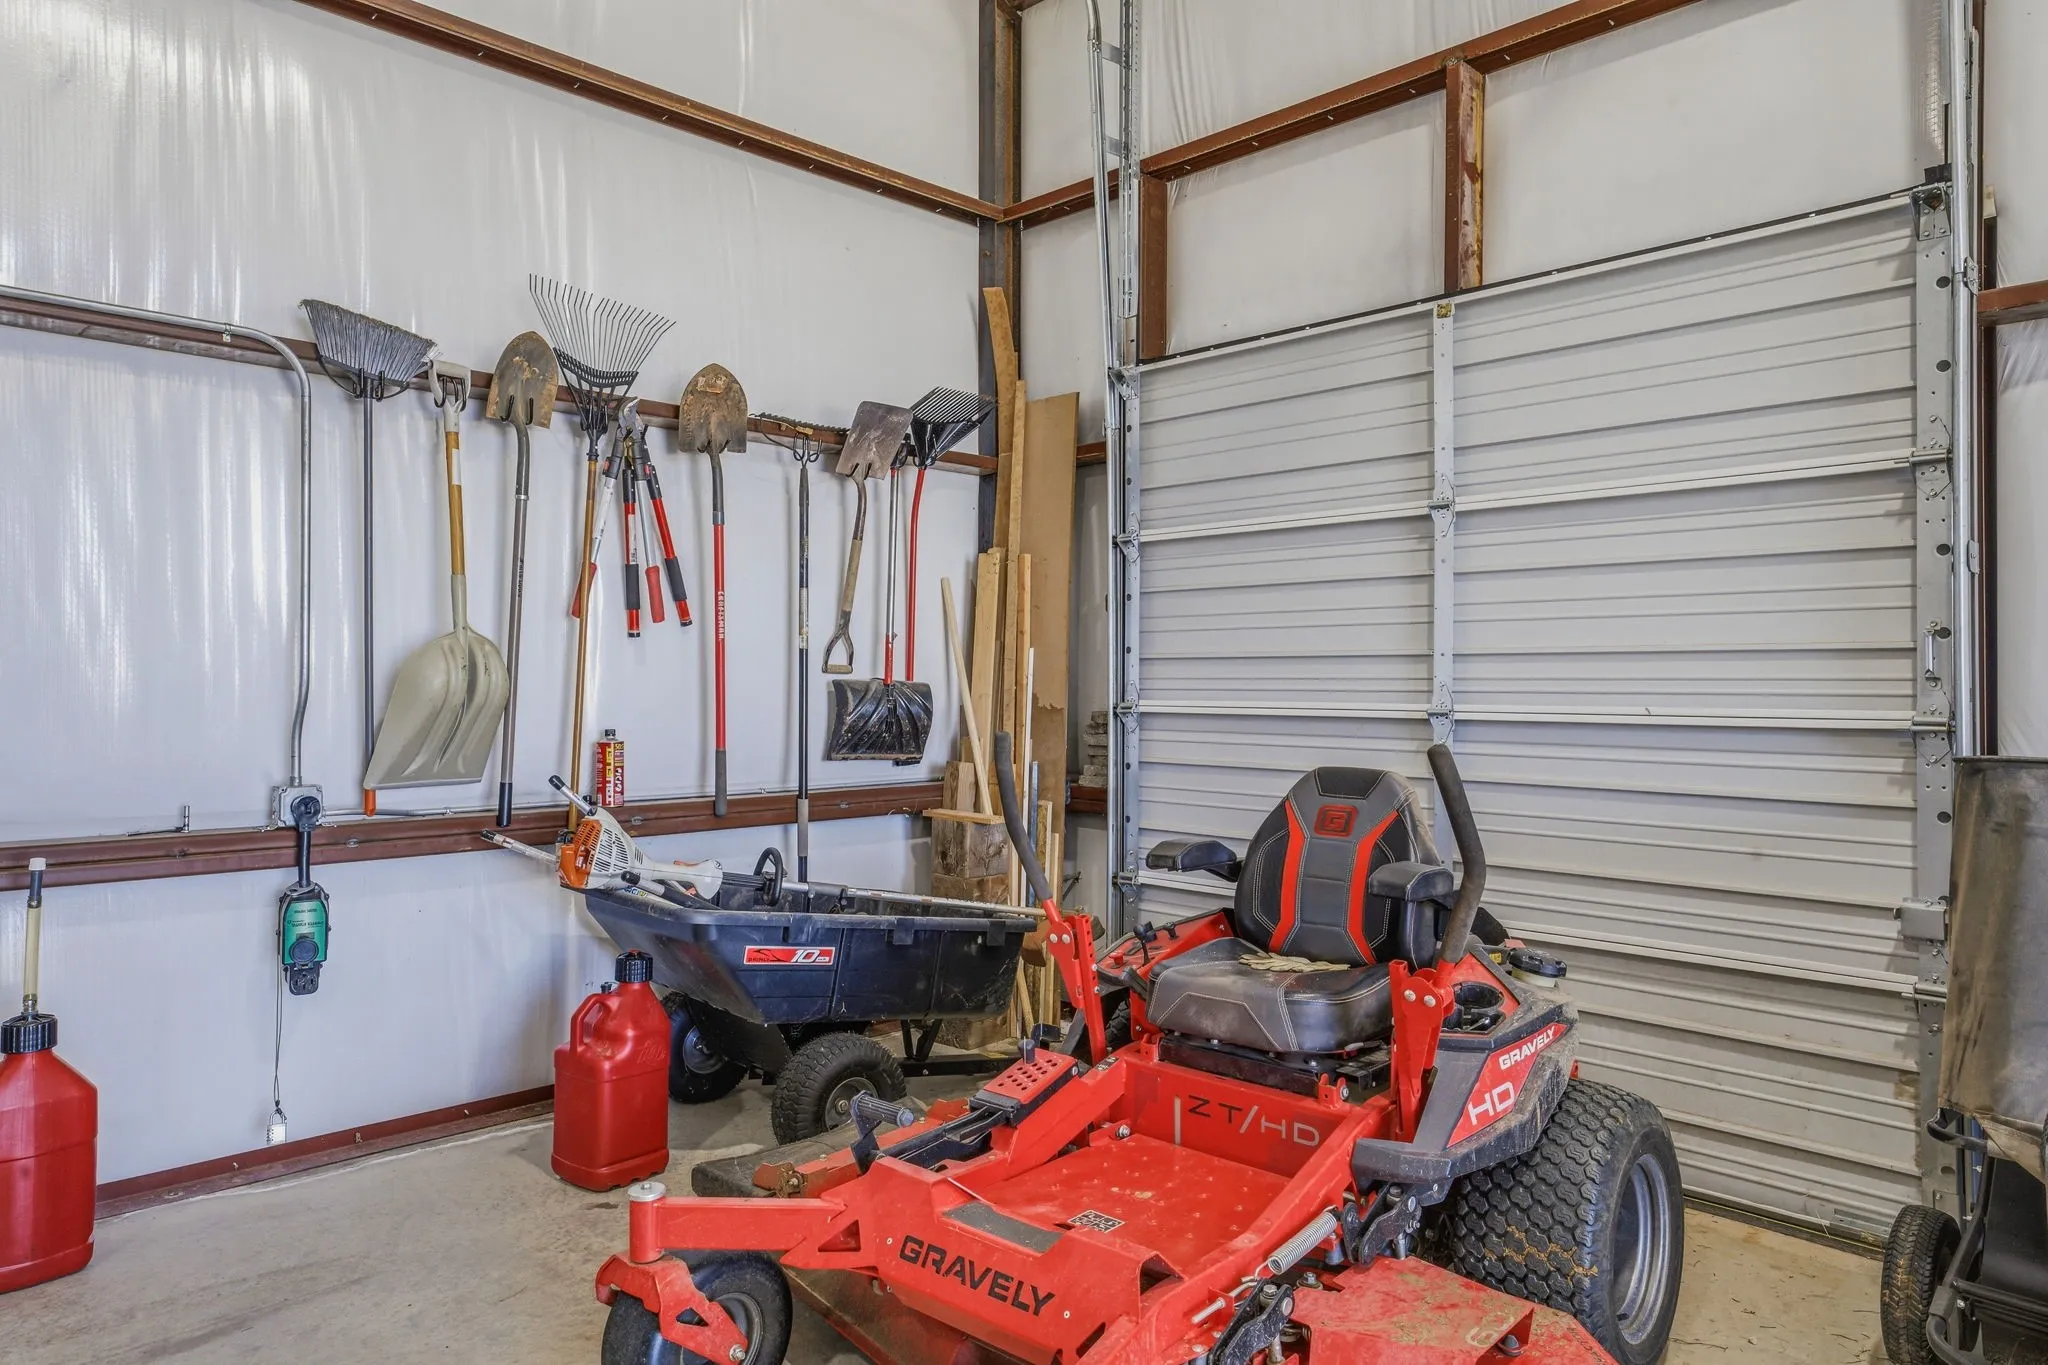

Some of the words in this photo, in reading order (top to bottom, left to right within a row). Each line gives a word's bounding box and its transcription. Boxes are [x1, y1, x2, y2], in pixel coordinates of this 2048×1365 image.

[790, 949, 821, 963] 10
[1498, 1026, 1555, 1070] GRAVELY
[1467, 1081, 1515, 1126] HD
[898, 1234, 1056, 1317] GRAVELY
